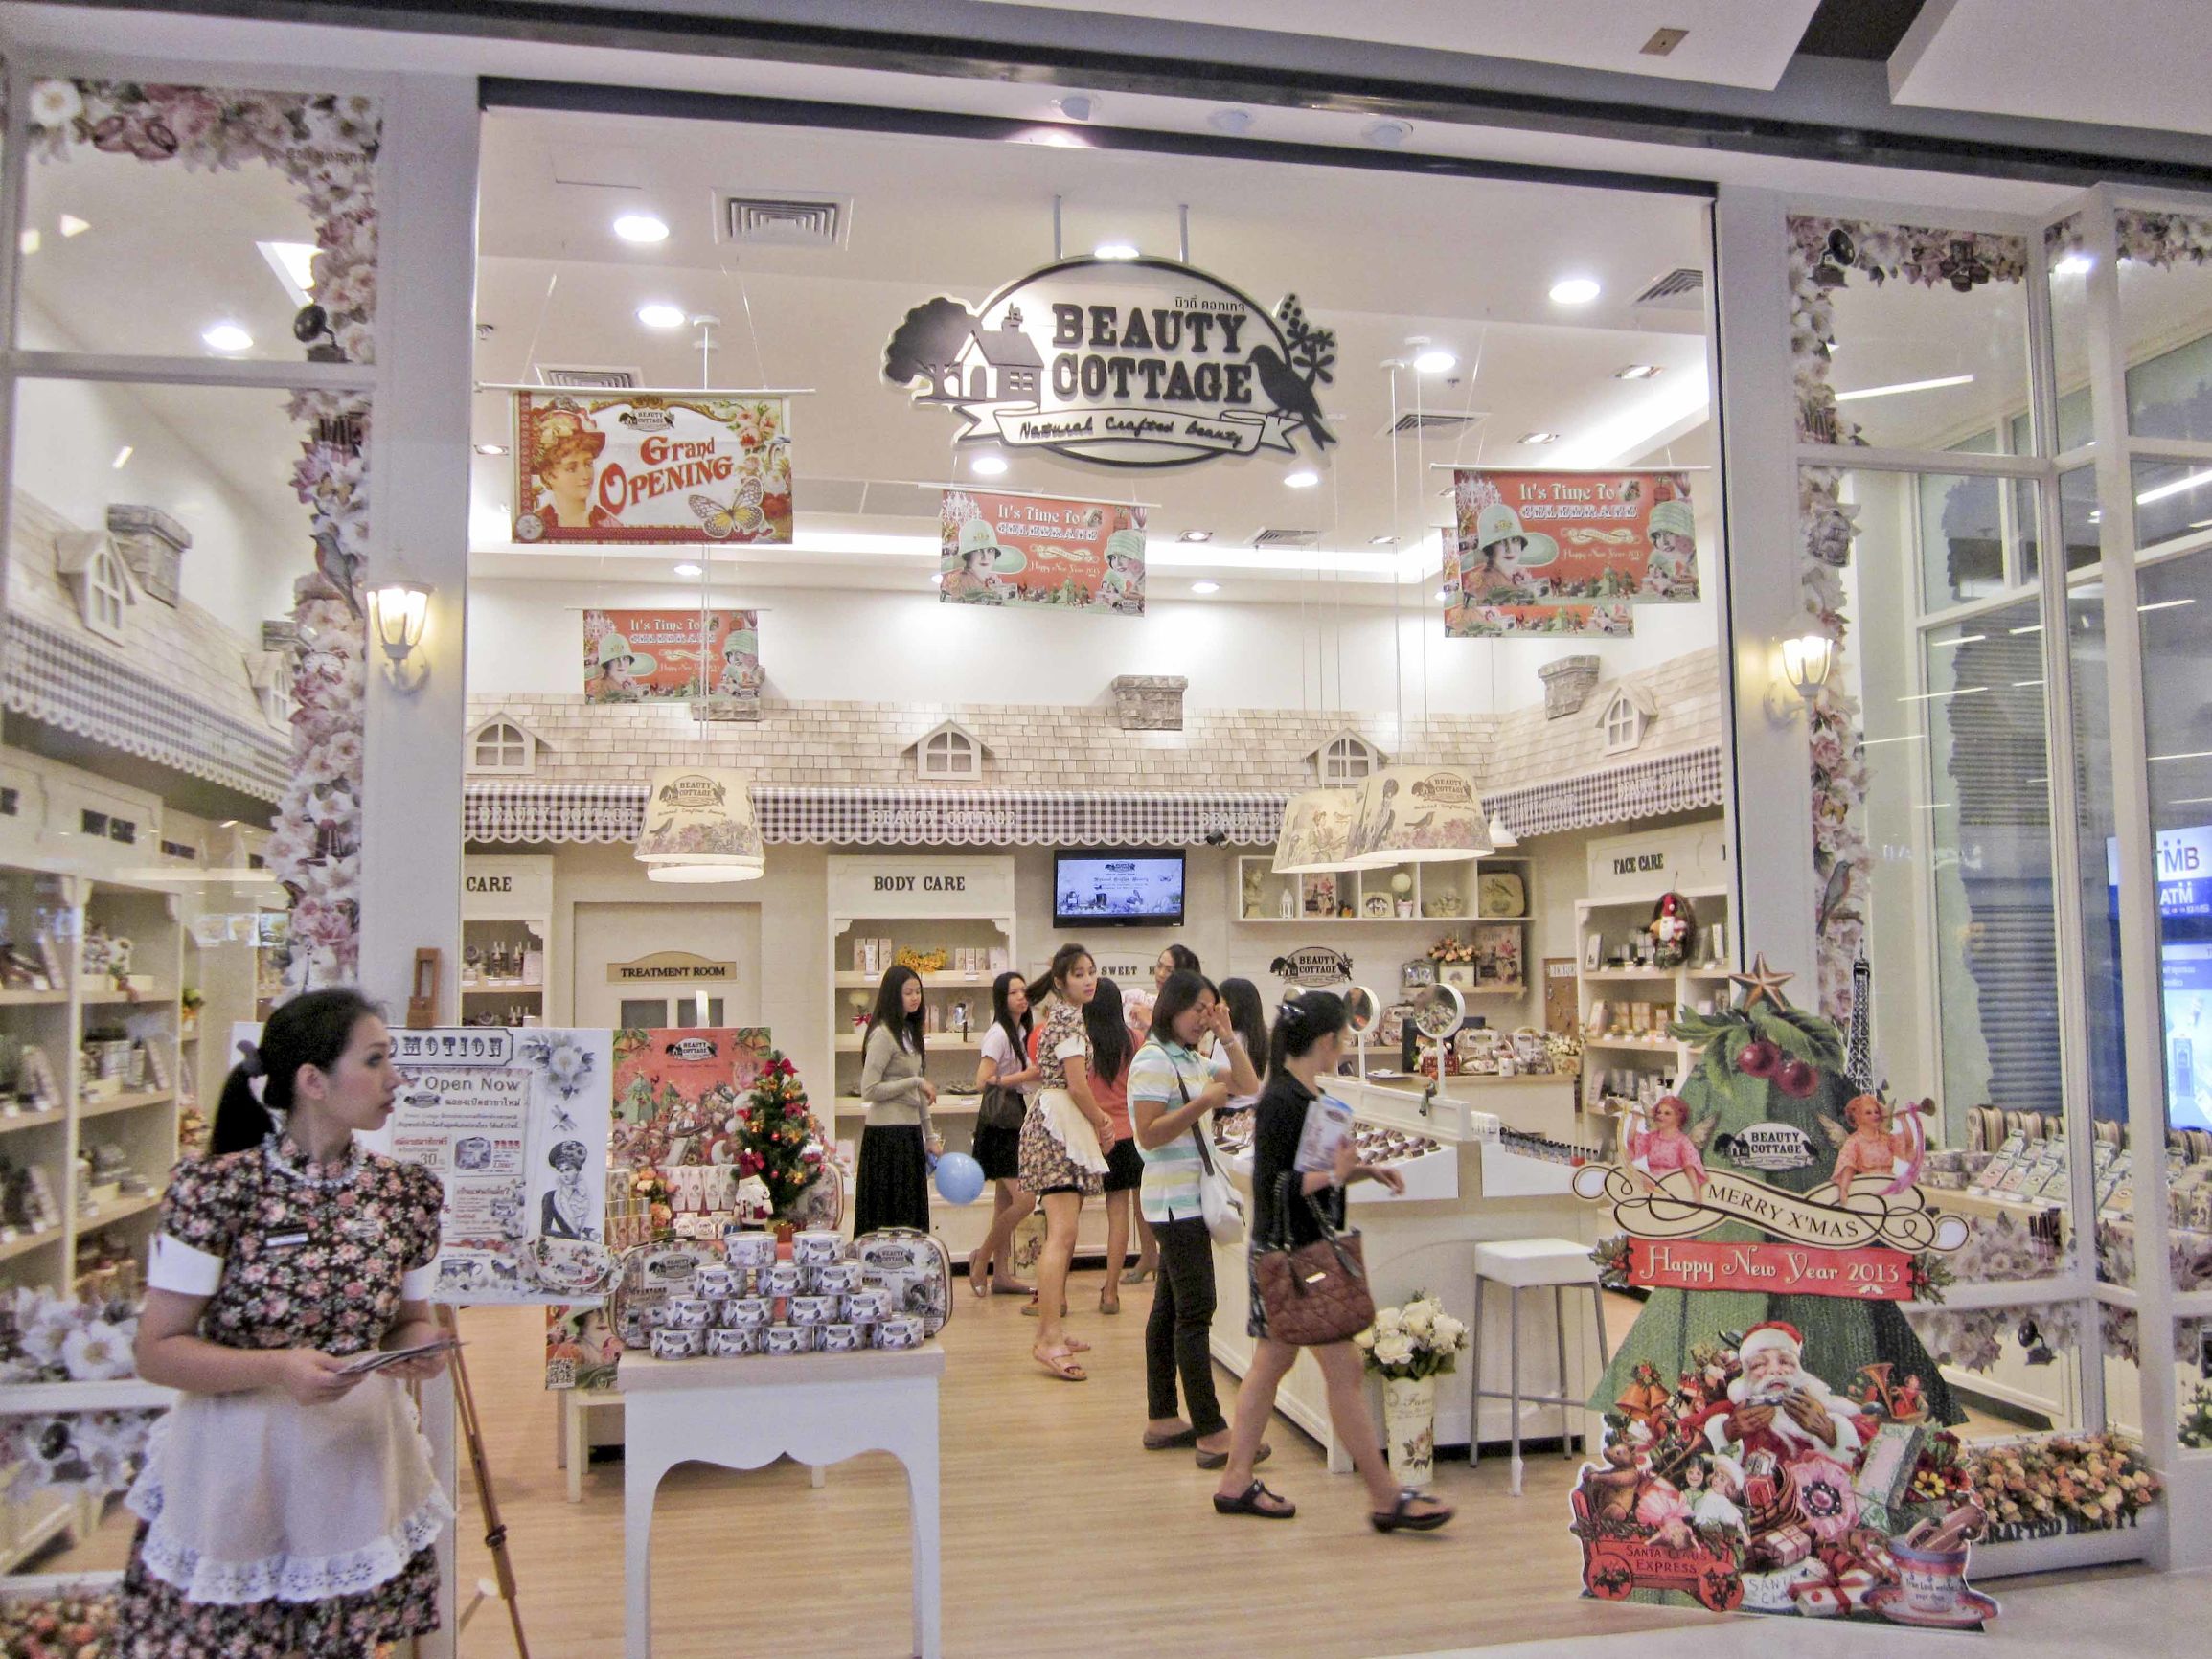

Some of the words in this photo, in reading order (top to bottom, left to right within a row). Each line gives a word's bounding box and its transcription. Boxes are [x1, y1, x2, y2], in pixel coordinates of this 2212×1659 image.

[1052, 303, 1247, 353] BEAUTY
[1053, 353, 1252, 404] COTTAGE
[1019, 416, 1094, 440] Natural
[1105, 416, 1174, 437] Crafted
[640, 436, 716, 466] Grand
[599, 456, 734, 516] OPENING
[1520, 483, 1547, 500] It's
[1551, 483, 1591, 502] Time
[1596, 483, 1616, 500] To
[998, 504, 1021, 519] It's
[1025, 506, 1060, 523] Time
[1063, 510, 1080, 524] To
[630, 619, 650, 631] It's
[654, 619, 683, 632] Time
[687, 618, 700, 630] To
[479, 807, 550, 822] BEAUTY
[873, 810, 937, 825] BEAUTY
[947, 811, 1015, 825] COTTAGE
[1199, 812, 1261, 826] BEAUTY
[1613, 856, 1636, 875] FACE
[1638, 853, 1664, 872] CARE
[2157, 839, 2201, 874] MB
[467, 876, 512, 892] CARE
[874, 875, 915, 891] BODY
[923, 875, 966, 891] CARE
[2160, 881, 2194, 905] ATM
[1299, 956, 1336, 965] BEAUTY
[621, 967, 690, 977] TREATMENT
[693, 966, 725, 976] ROOM
[1101, 966, 1137, 975] SWEET
[1299, 966, 1337, 974] COTTAGE
[387, 1036, 504, 1058] OMOTION
[425, 1076, 472, 1093] Open
[481, 1078, 520, 1091] Now
[1751, 1132, 1800, 1142] BEAUTY
[1751, 1144, 1801, 1153] COTTAGE
[422, 1152, 437, 1166] 30
[1709, 1184, 1784, 1220] MERRY
[1787, 1212, 1859, 1238] X'MAS
[1639, 1246, 1715, 1282] Happy
[1722, 1246, 1777, 1278] New
[1785, 1252, 1839, 1284] Year
[1847, 1263, 1900, 1283] 2013
[1977, 1517, 2062, 1545] RAFTED
[1626, 1545, 1662, 1558] SANTA
[1669, 1548, 1708, 1561] CLAUS
[1636, 1560, 1698, 1574] EXPRESS
